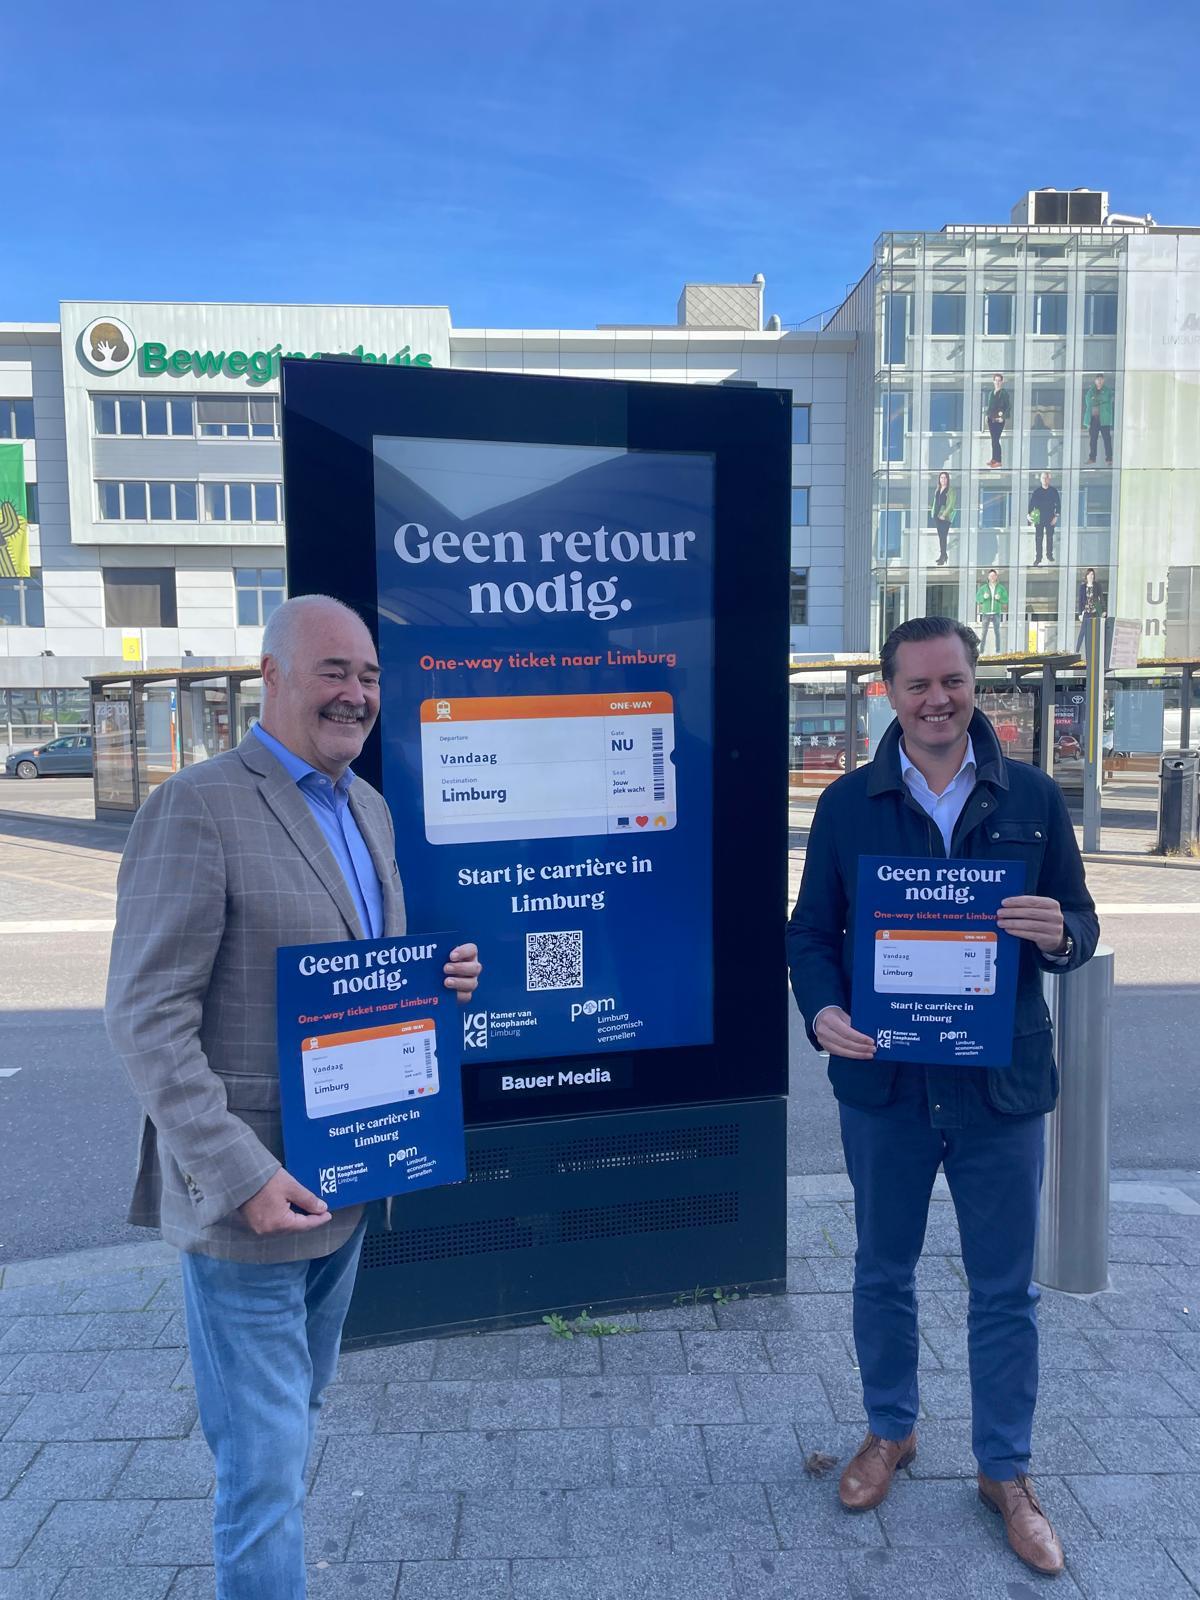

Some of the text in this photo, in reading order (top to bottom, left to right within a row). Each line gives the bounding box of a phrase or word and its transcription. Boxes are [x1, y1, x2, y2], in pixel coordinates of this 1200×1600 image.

[142, 343, 433, 382] Beweghuis
[394, 523, 696, 563] Geen retour
[469, 570, 632, 621] nodig.
[420, 650, 677, 672] One-way ticket naar Limburg
[610, 701, 653, 710] ONE-WAY
[440, 735, 468, 743] Departure
[611, 739, 634, 751] NU
[440, 753, 497, 766] Vandaag
[441, 776, 478, 785] Destination
[441, 787, 507, 803] Limburg
[458, 855, 653, 886] Start je carrière in
[877, 865, 1006, 883] Geen retour
[905, 884, 975, 904] nodig.
[511, 890, 605, 913] Limburg
[874, 911, 914, 921] One-way
[916, 911, 941, 920] ticket
[966, 912, 999, 921] Limbur
[299, 943, 437, 976] Geen retour
[882, 969, 913, 977] Limburg
[333, 968, 407, 996] nodig.
[298, 996, 439, 1024] One-way ticket naar Limburg
[890, 1001, 974, 1012] Start je carrière in
[490, 1012, 516, 1020] Kamer
[597, 1012, 629, 1024] Limburg
[911, 1014, 952, 1023] Limburg
[490, 1018, 537, 1029] Koophandel
[597, 1020, 644, 1034] economisch
[490, 1028, 521, 1037] Limburg
[598, 1031, 636, 1043] versnellen
[402, 1046, 415, 1055] NU
[312, 1063, 344, 1074] Vandaag
[502, 1068, 611, 1090] Bauer Media
[314, 1082, 349, 1095] Limburg
[329, 1109, 420, 1137] Start je carrière in
[354, 1130, 399, 1148] Limburg
